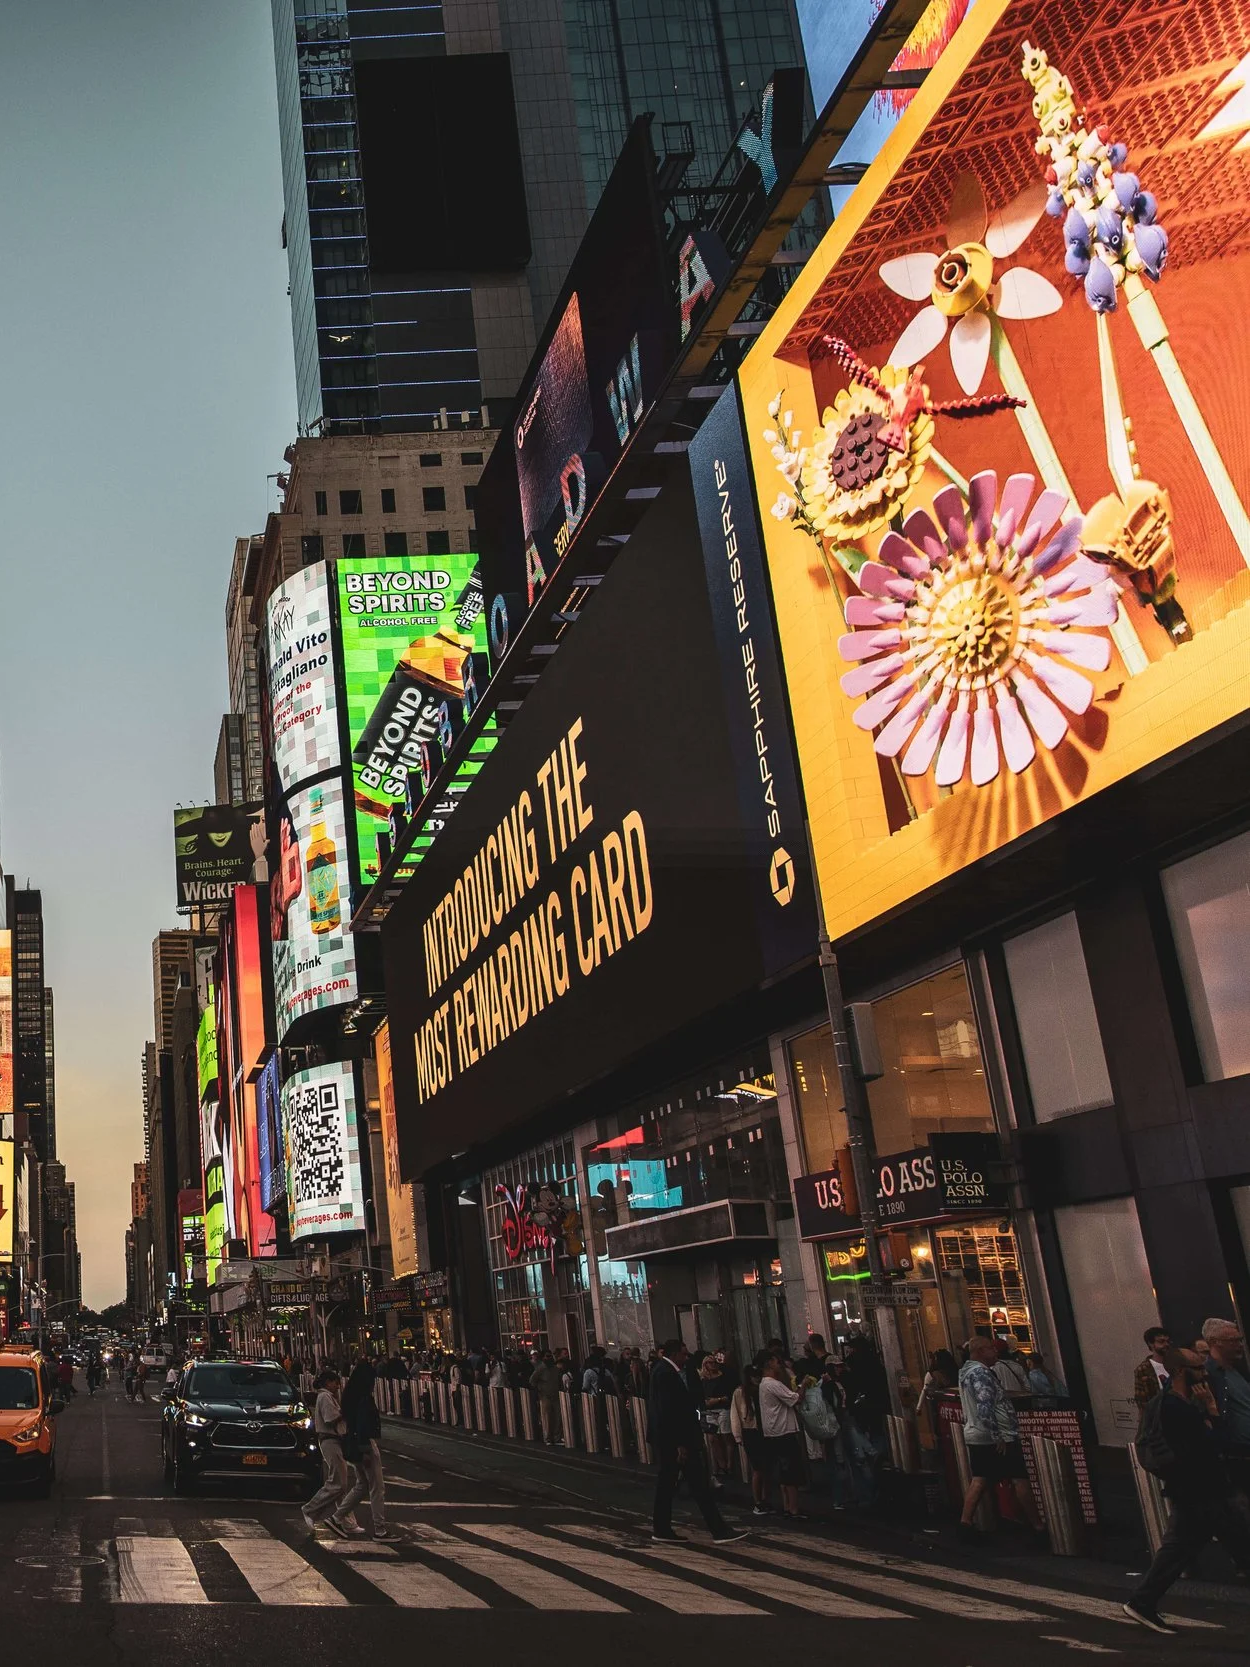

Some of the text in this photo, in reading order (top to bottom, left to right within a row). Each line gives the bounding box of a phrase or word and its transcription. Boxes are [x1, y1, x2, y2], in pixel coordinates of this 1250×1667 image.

[345, 570, 452, 593] BEYOND
[347, 592, 446, 615] SPIRITS
[454, 591, 477, 626] ALCOHOL
[461, 592, 485, 631] FREE
[359, 617, 438, 628] ALCOHOL FREE
[295, 631, 328, 654] Vito
[295, 679, 312, 695] the
[282, 703, 323, 732] Category
[359, 686, 423, 791] BEYOND
[741, 637, 782, 839] SAPPHIRE
[382, 703, 440, 798] SPIRITS
[184, 857, 245, 870] Brains. Heart.
[422, 790, 539, 998] INTRODUCING
[536, 716, 594, 865] THE
[195, 867, 234, 878] Courage.
[297, 955, 322, 975] Drink
[413, 809, 654, 1105] MOST REWARDING CARD
[898, 1155, 937, 1194] ASS
[940, 1159, 968, 1172] U.S.
[942, 1172, 983, 1184] POLO
[945, 1184, 989, 1197] ASSN.
[270, 1293, 291, 1304] GIFTS
